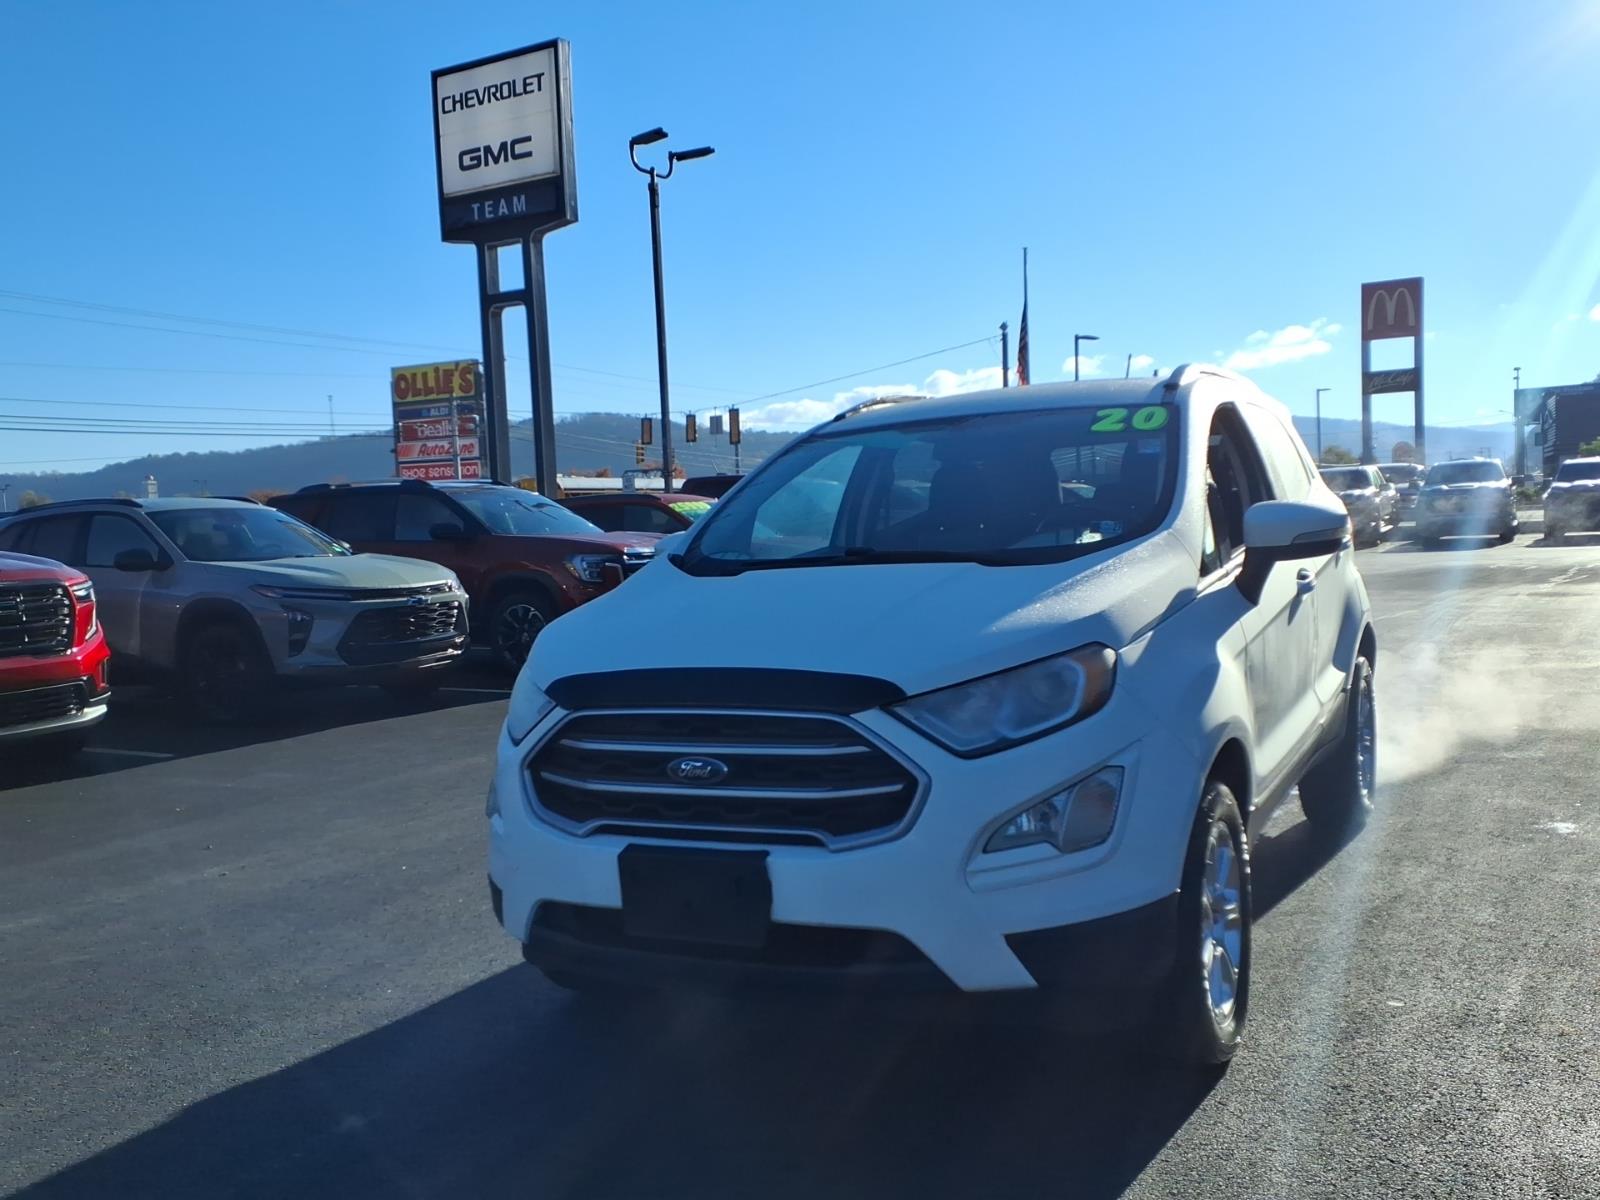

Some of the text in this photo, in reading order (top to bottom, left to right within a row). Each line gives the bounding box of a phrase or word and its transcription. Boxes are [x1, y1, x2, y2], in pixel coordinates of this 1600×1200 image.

[441, 72, 545, 115] CHEVROLET
[458, 135, 533, 172] GMC
[471, 194, 526, 221] TEAM
[1090, 405, 1169, 432] 20
[417, 442, 475, 457] AutoZne
[678, 760, 713, 778] Ford
